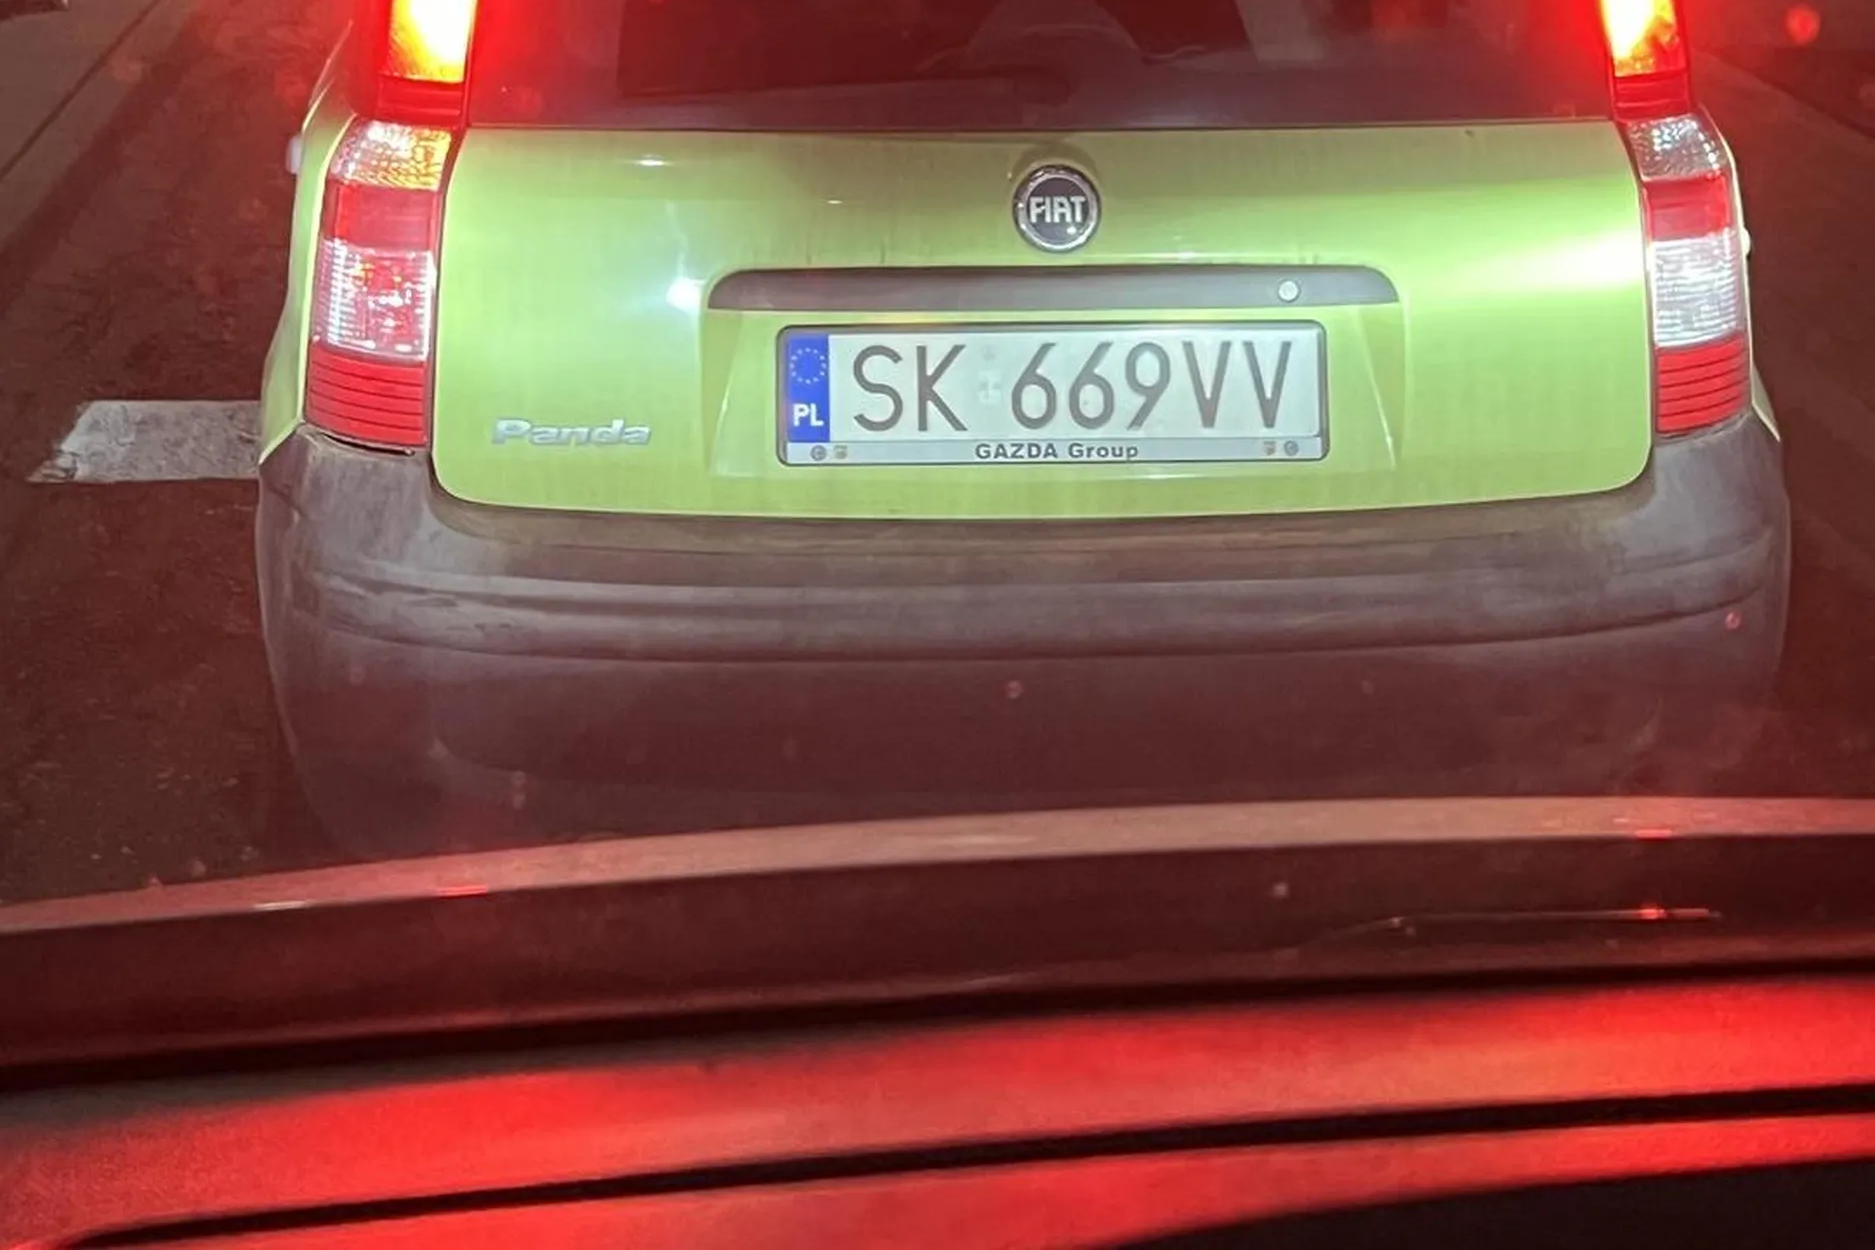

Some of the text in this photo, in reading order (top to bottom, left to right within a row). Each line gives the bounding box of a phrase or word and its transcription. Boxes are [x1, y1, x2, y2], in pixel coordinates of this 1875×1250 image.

[1029, 195, 1086, 224] FIAT
[853, 340, 1292, 432] SK 669VV
[793, 403, 824, 427] PL
[492, 418, 651, 445] Panda
[975, 442, 1139, 465] GAZDA Group
